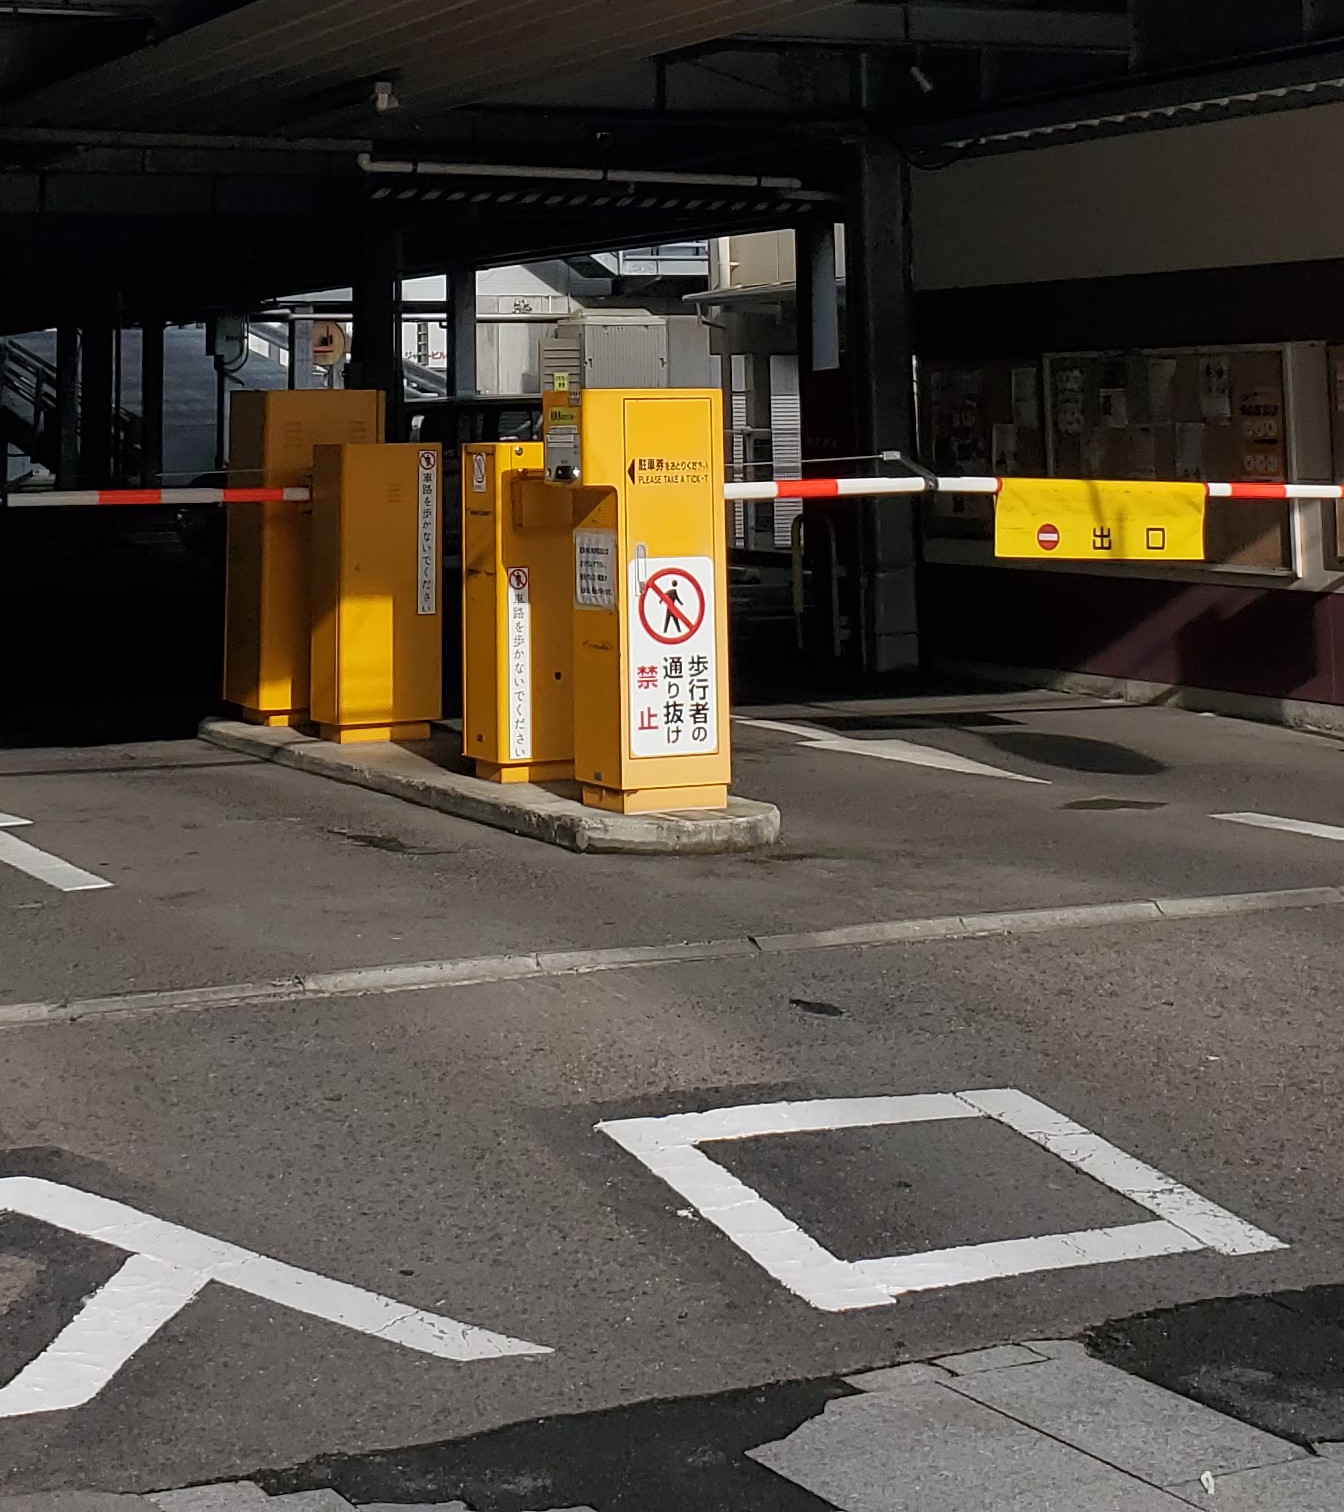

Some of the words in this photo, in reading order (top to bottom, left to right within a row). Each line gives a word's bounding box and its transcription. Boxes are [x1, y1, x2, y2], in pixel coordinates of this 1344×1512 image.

[638, 475, 662, 484] PLEASE
[1092, 525, 1167, 552] 出口
[513, 593, 526, 757] 車路を歩かないでください
[637, 664, 660, 731] 禁止
[663, 656, 685, 744] 通り抜け
[687, 654, 710, 743] 歩行者の
